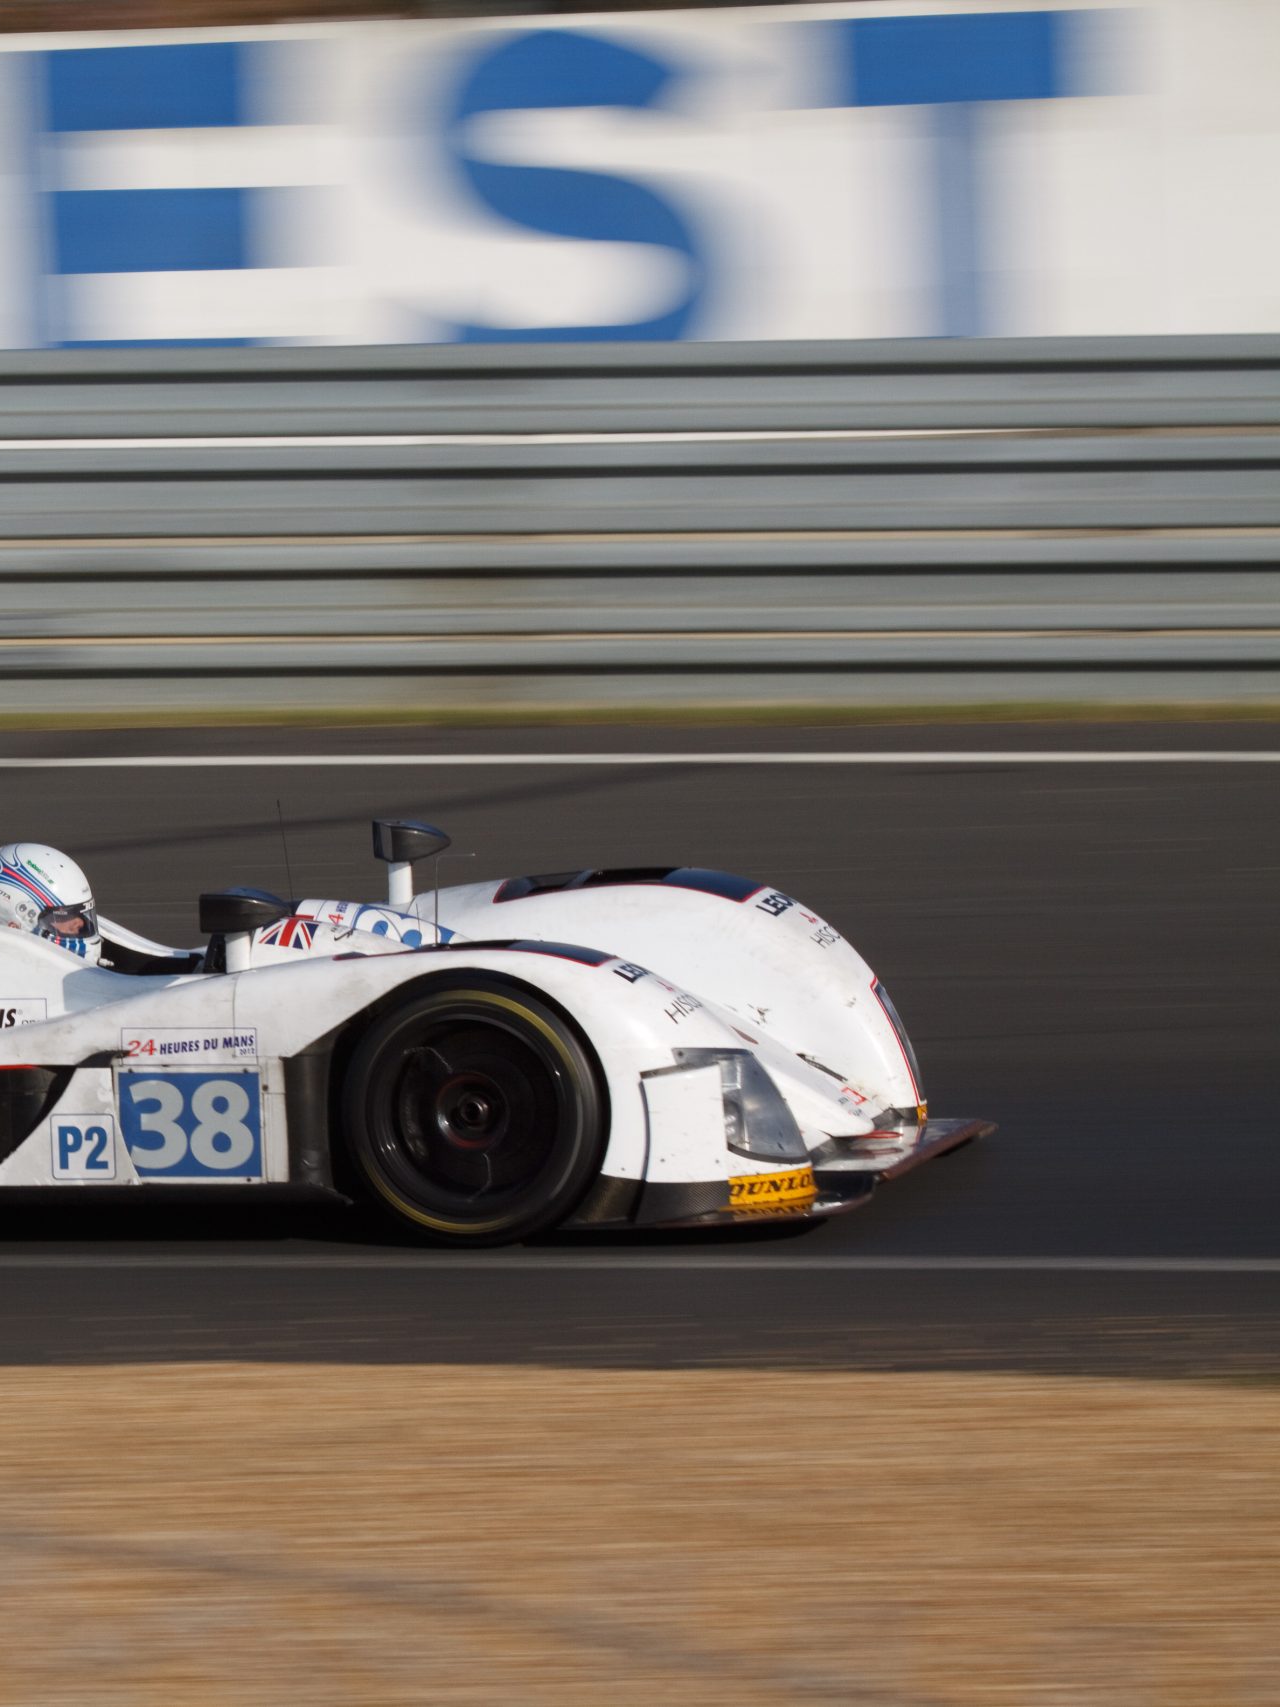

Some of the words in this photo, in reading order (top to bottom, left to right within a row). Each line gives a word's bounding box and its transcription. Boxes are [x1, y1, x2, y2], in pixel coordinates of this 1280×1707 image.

[127, 1039, 157, 1057] 24
[160, 1040, 200, 1055] HEURES
[203, 1038, 218, 1050] DU
[222, 1034, 254, 1049] MANS
[130, 1080, 254, 1170] 38
[58, 1126, 108, 1170] P2
